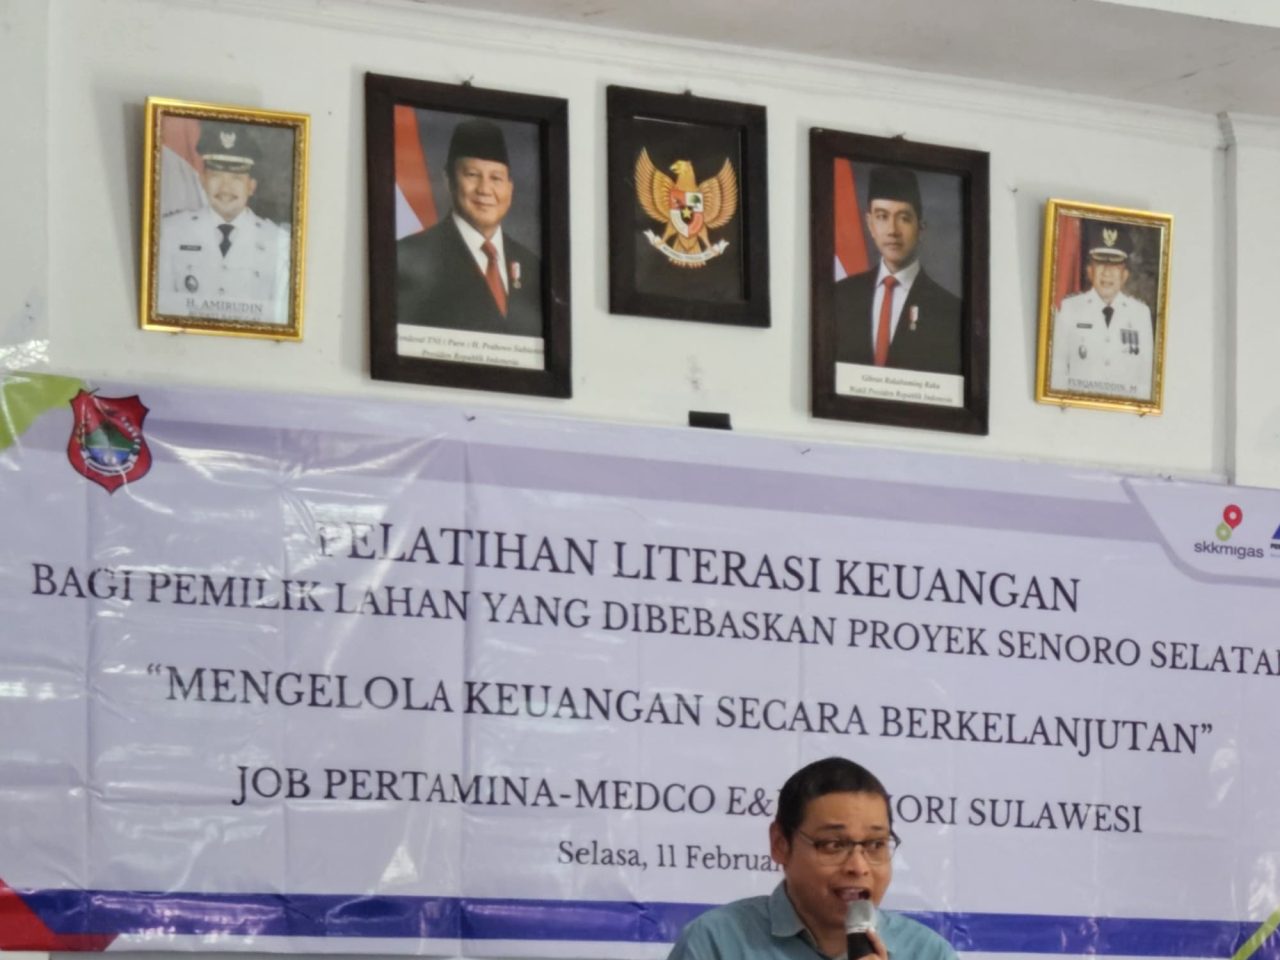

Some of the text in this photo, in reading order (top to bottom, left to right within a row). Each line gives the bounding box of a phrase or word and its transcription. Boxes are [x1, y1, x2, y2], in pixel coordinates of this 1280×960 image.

[318, 521, 1080, 613] PELATIHAN LITERASI KEUANGAN
[1194, 541, 1265, 559] skkmigas
[32, 563, 131, 600] BAGI
[147, 571, 324, 612] PEMILIK
[334, 582, 471, 621] LAHAN
[482, 591, 591, 629] YANG
[601, 600, 836, 646] DIBEBASKAN
[847, 619, 990, 655] PROYEK
[998, 630, 1141, 667] SENORO
[464, 681, 703, 726] KEUANGAN
[715, 696, 869, 736] SECARA
[232, 766, 311, 806] JOB
[323, 770, 716, 815] PERTAMINA-MEDCO
[968, 797, 1142, 833] SULAWESI
[558, 840, 648, 870] Selasa,
[657, 844, 676, 868] 11
